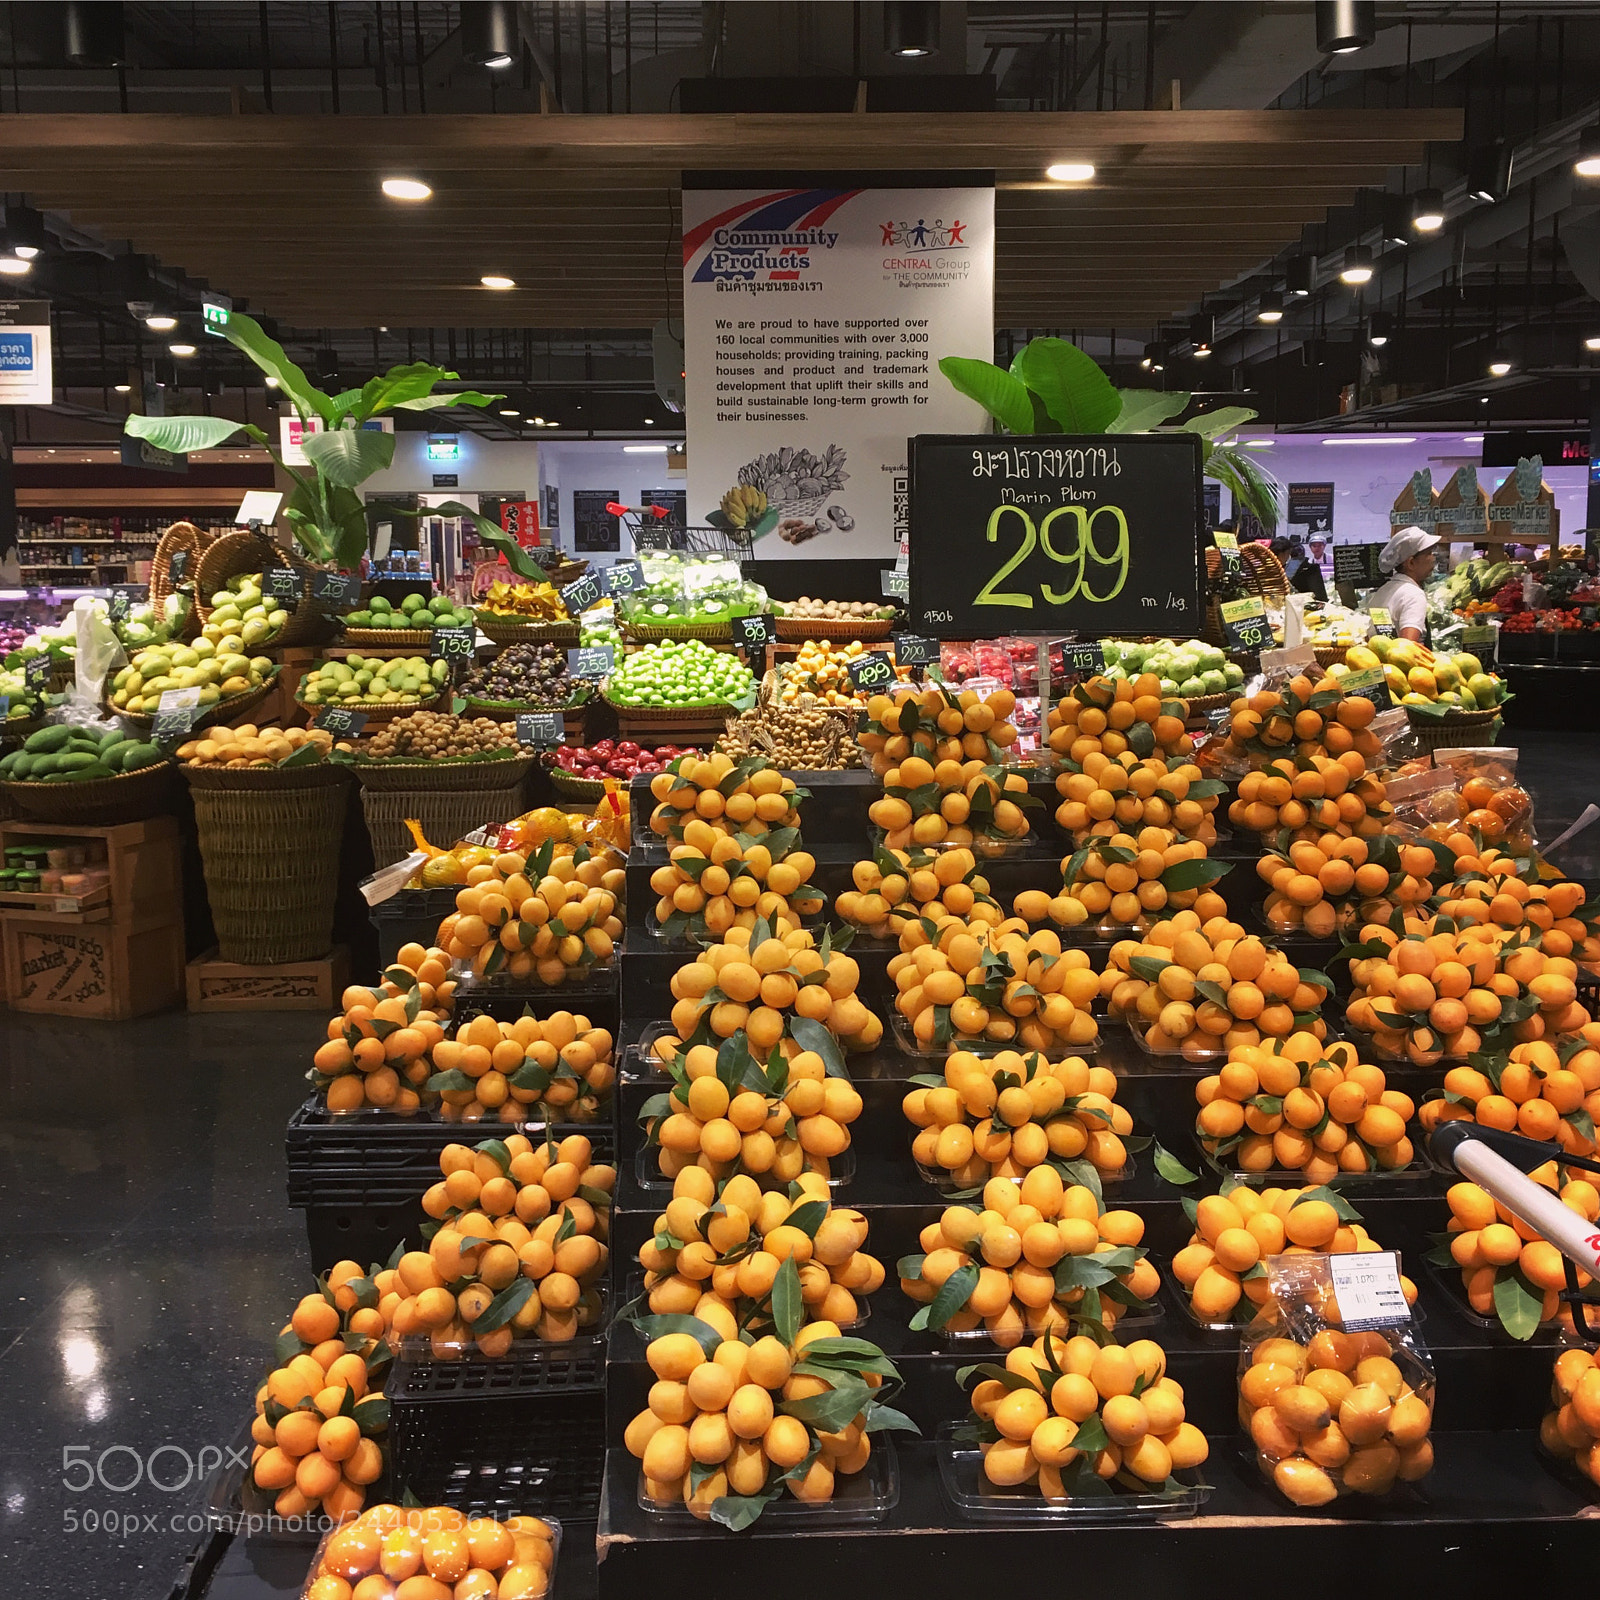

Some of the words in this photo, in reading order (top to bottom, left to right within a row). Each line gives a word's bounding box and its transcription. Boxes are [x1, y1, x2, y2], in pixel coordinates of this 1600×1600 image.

[714, 229, 839, 249] Community
[714, 252, 810, 269] Products
[883, 258, 932, 270] CENTRAL
[935, 258, 970, 271] Group
[913, 272, 969, 280] COMMUNITY
[716, 279, 823, 296] สินค้าชุมชนของเรา
[715, 318, 733, 329] We
[737, 320, 756, 329] are
[760, 318, 793, 331] proud
[797, 318, 809, 328] to
[813, 318, 840, 328] have
[844, 317, 899, 331] supported
[904, 319, 929, 328] over
[716, 334, 735, 344] 160
[739, 334, 766, 344] local
[770, 334, 840, 344] communities
[843, 333, 867, 343] with
[871, 335, 895, 343] over
[900, 332, 929, 344] 3,000
[715, 350, 781, 361] households;
[784, 349, 835, 362] providing
[838, 349, 882, 362] training,
[886, 348, 929, 361] packing
[716, 365, 755, 375] houses
[763, 364, 784, 375] and
[792, 364, 836, 377] product
[843, 364, 864, 374] and
[872, 364, 929, 374] trademark
[716, 380, 786, 393] development
[790, 380, 812, 390] that
[816, 380, 843, 393] uplift
[847, 379, 872, 390] their
[876, 379, 904, 390] skills
[908, 379, 928, 389] and
[716, 396, 743, 406] build
[747, 395, 809, 406] sustainable
[813, 395, 866, 408] long-term
[870, 394, 909, 407] growth
[912, 394, 928, 404] for
[716, 411, 742, 422] their
[745, 411, 808, 421] businesses.
[972, 447, 1122, 479] มะปรางหวาน
[1001, 488, 1051, 504] Marin
[1061, 485, 1097, 502] Plum
[972, 505, 1130, 608] 299
[272, 579, 294, 595] 89
[609, 573, 633, 590] 79
[319, 584, 344, 598] 49
[570, 581, 599, 607] 109
[745, 627, 766, 641] 99
[1239, 628, 1261, 645] 89
[439, 639, 472, 655] 159
[577, 656, 608, 674] 259
[1073, 653, 1093, 668] 119
[858, 662, 890, 684] 499
[157, 711, 191, 731] 229
[322, 712, 352, 730] 149
[527, 722, 556, 739] 119
